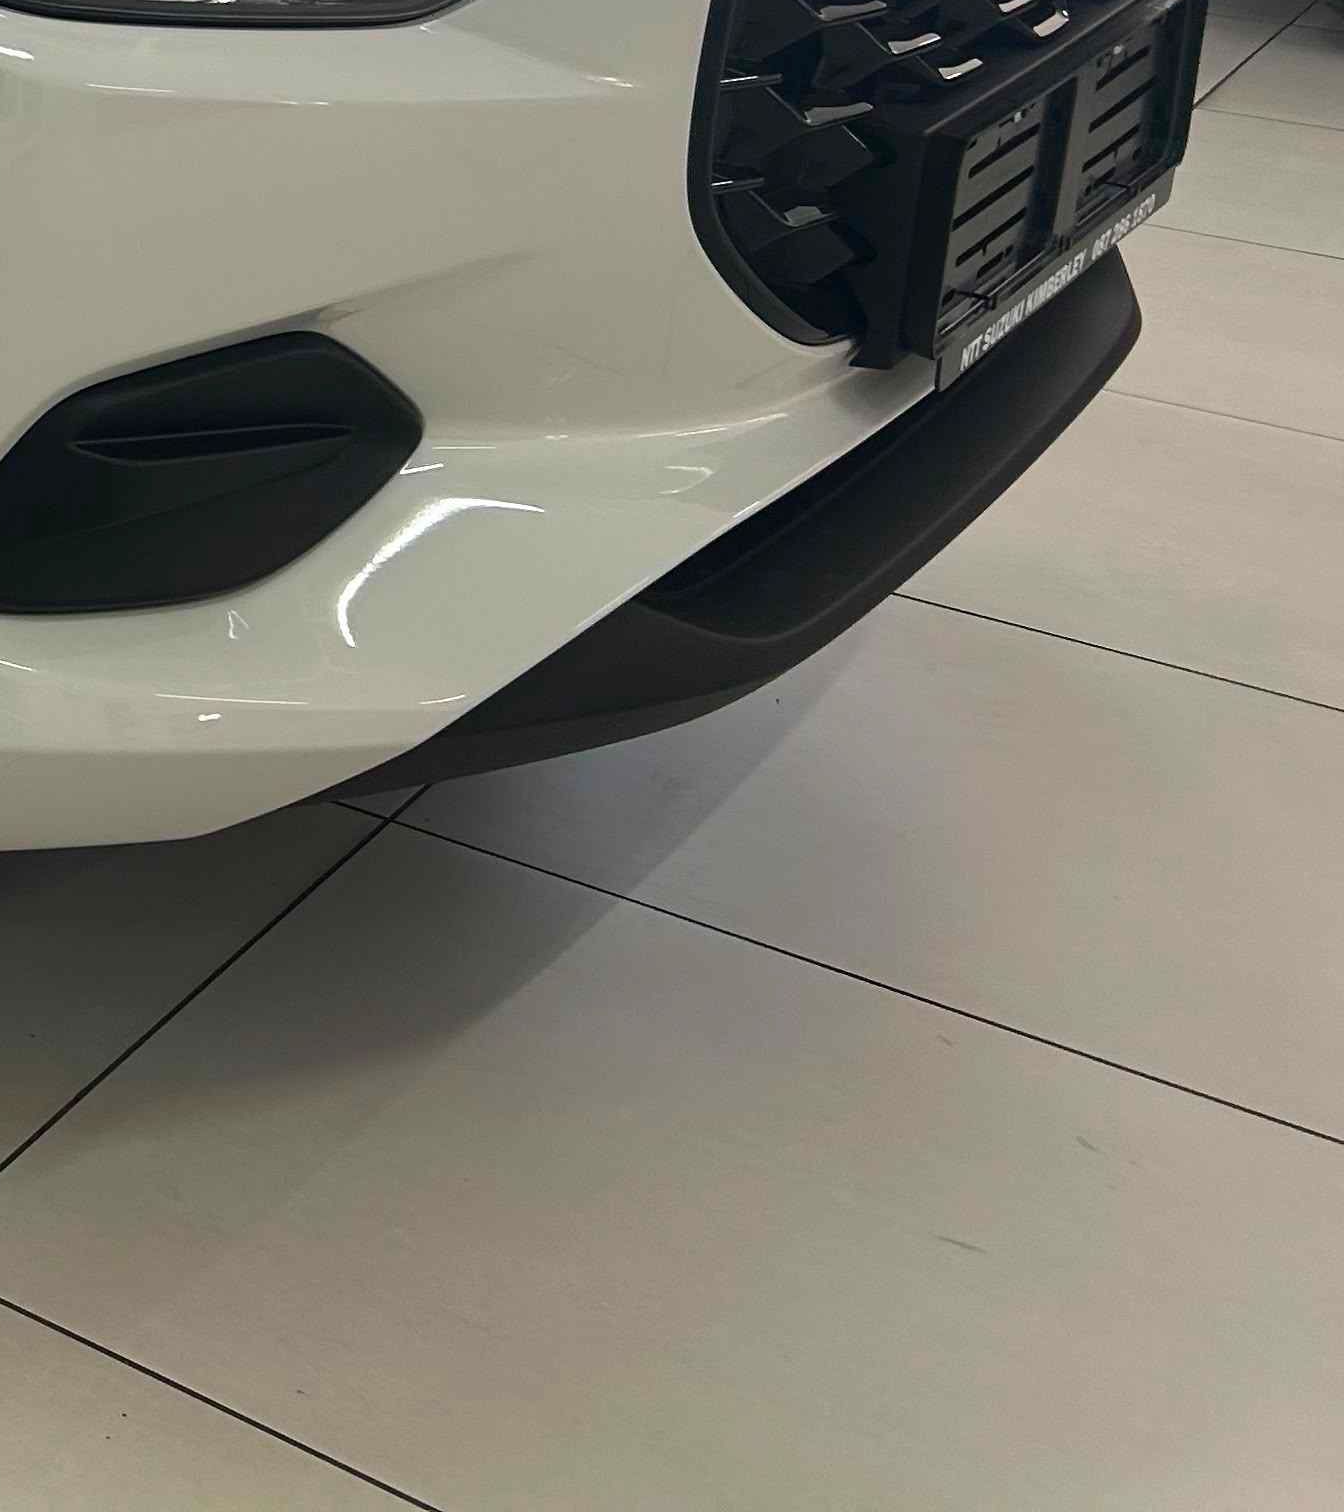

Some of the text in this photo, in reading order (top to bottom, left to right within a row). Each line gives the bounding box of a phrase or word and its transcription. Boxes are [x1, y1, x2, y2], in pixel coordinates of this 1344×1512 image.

[960, 334, 983, 372] NTT
[982, 298, 1026, 351] SUZUKI
[1025, 249, 1088, 317] KIMBERLEY
